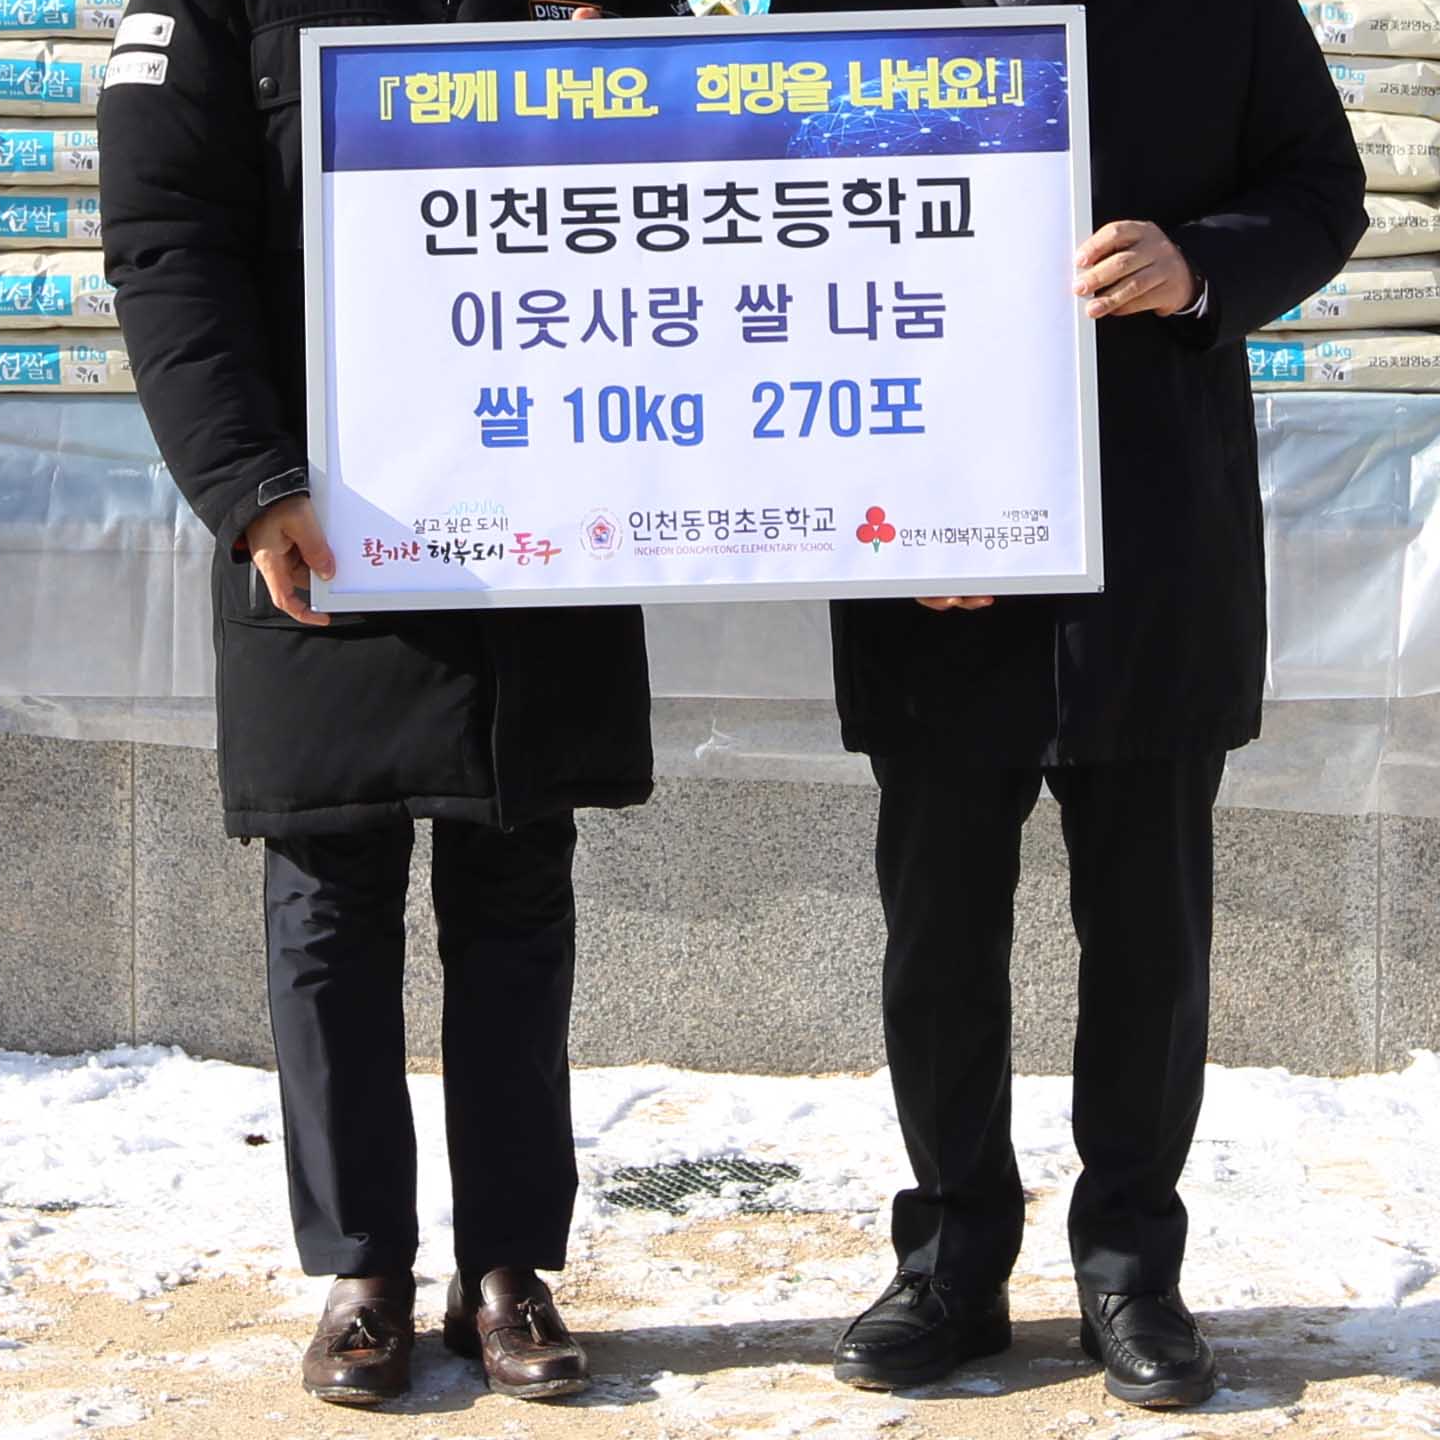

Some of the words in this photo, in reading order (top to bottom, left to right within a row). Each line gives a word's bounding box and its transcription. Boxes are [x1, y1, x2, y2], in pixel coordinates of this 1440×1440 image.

[695, 61, 832, 115] 희망을
[419, 178, 976, 256] 인천동명초등학교
[450, 287, 703, 351] 이웃사랑
[734, 284, 793, 343] 쌀
[827, 281, 947, 342] 나눔
[69, 346, 107, 363] 10kg
[1313, 343, 1352, 359] 10kg
[473, 384, 534, 449] 쌀
[564, 384, 704, 447] 10kg
[752, 376, 925, 439] 270포
[412, 518, 441, 534] 살고
[444, 518, 472, 532] 싶은
[476, 517, 509, 531] 도시!
[629, 507, 836, 542] 인천동명초등학교
[900, 529, 926, 546] 인천
[931, 526, 1049, 550] 사회복지공동모금회
[361, 538, 421, 565] 활기찬
[427, 539, 504, 566] 행복도시
[509, 533, 562, 565] 동구
[634, 546, 674, 555] INCHEON
[741, 544, 798, 553] ELEMENTARY
[800, 543, 835, 551] SCHOOL
